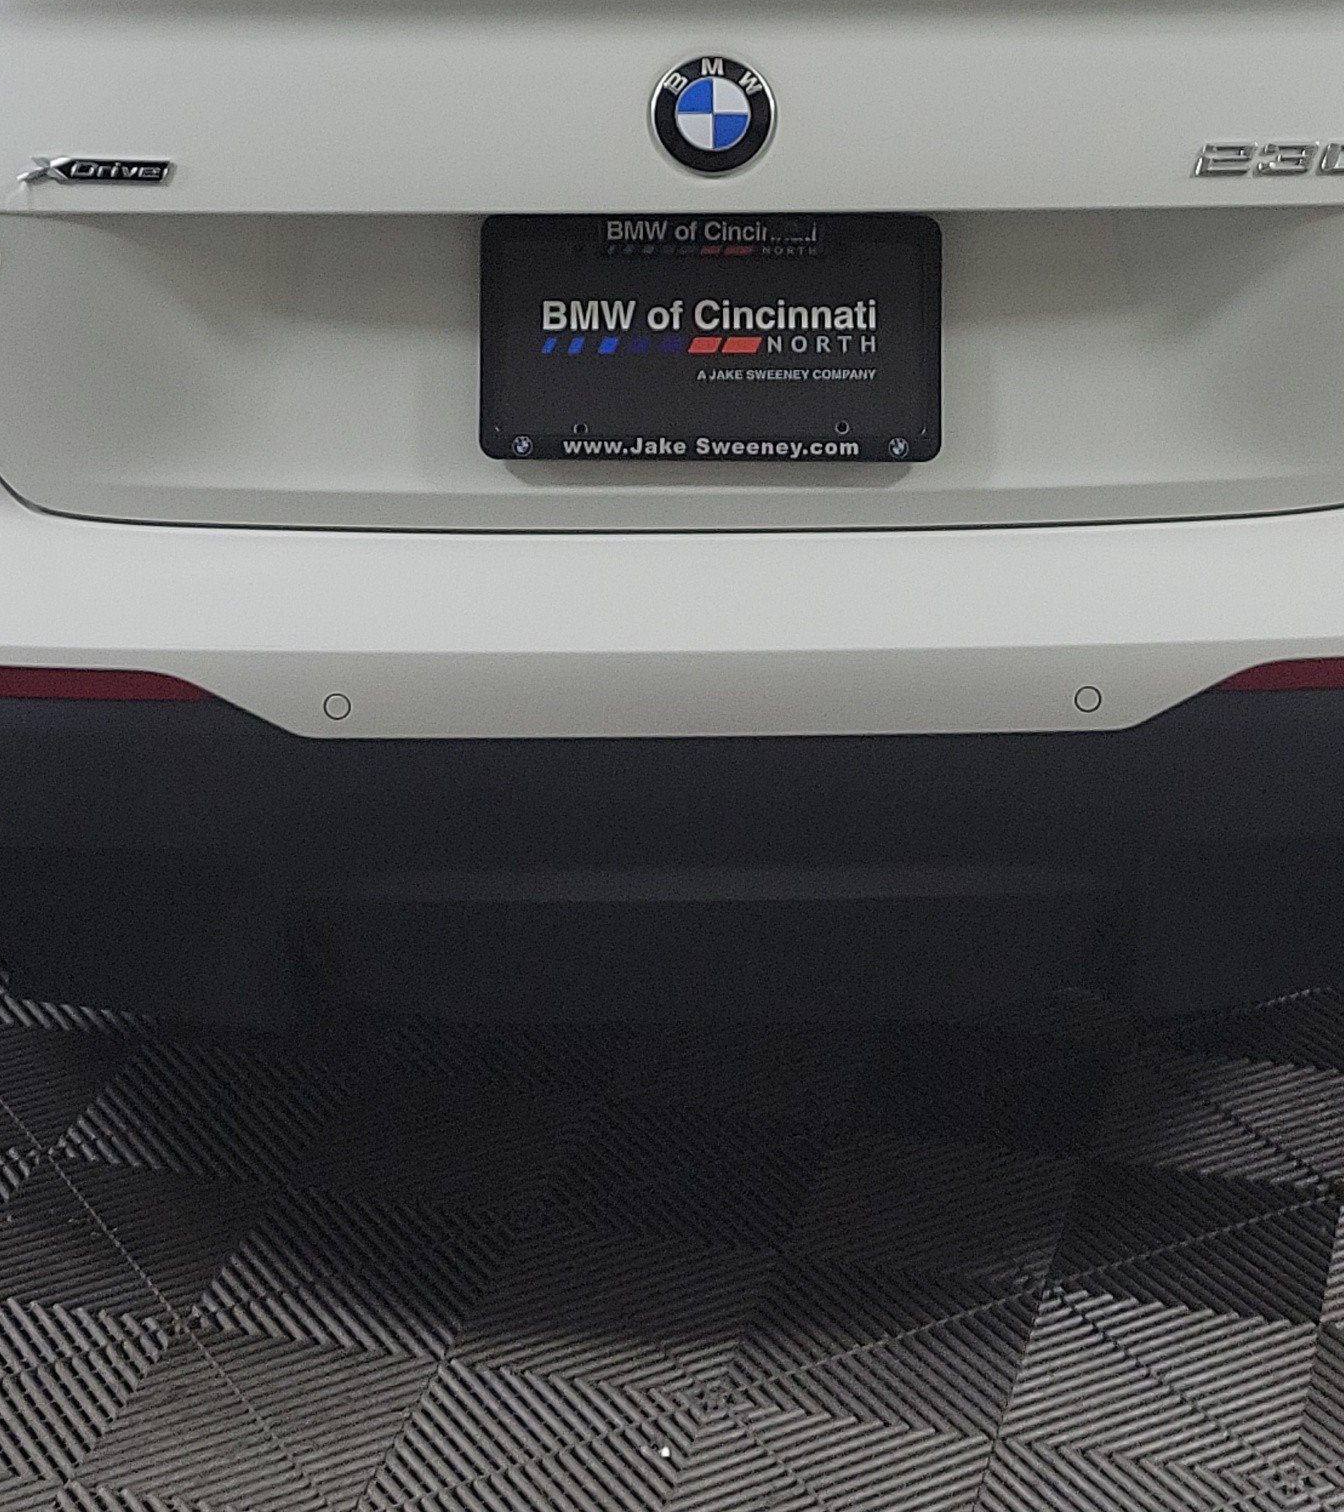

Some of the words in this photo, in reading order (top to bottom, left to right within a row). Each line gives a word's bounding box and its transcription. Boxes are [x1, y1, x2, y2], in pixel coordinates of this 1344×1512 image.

[663, 58, 763, 96] BMW
[607, 220, 668, 240] BMW
[674, 220, 697, 240] of
[705, 221, 816, 242] Cincii
[762, 246, 816, 256] NORTH
[542, 300, 636, 331] BMW
[647, 300, 684, 331] of
[694, 299, 876, 330] Cincinnati
[767, 335, 876, 354] NORTH
[697, 370, 707, 380] A
[709, 369, 744, 380] JAKE
[746, 369, 809, 381] SWEENEY
[812, 369, 876, 381] COMPANY
[563, 437, 687, 457] www.Jake
[696, 437, 860, 460] Sweeney.com
